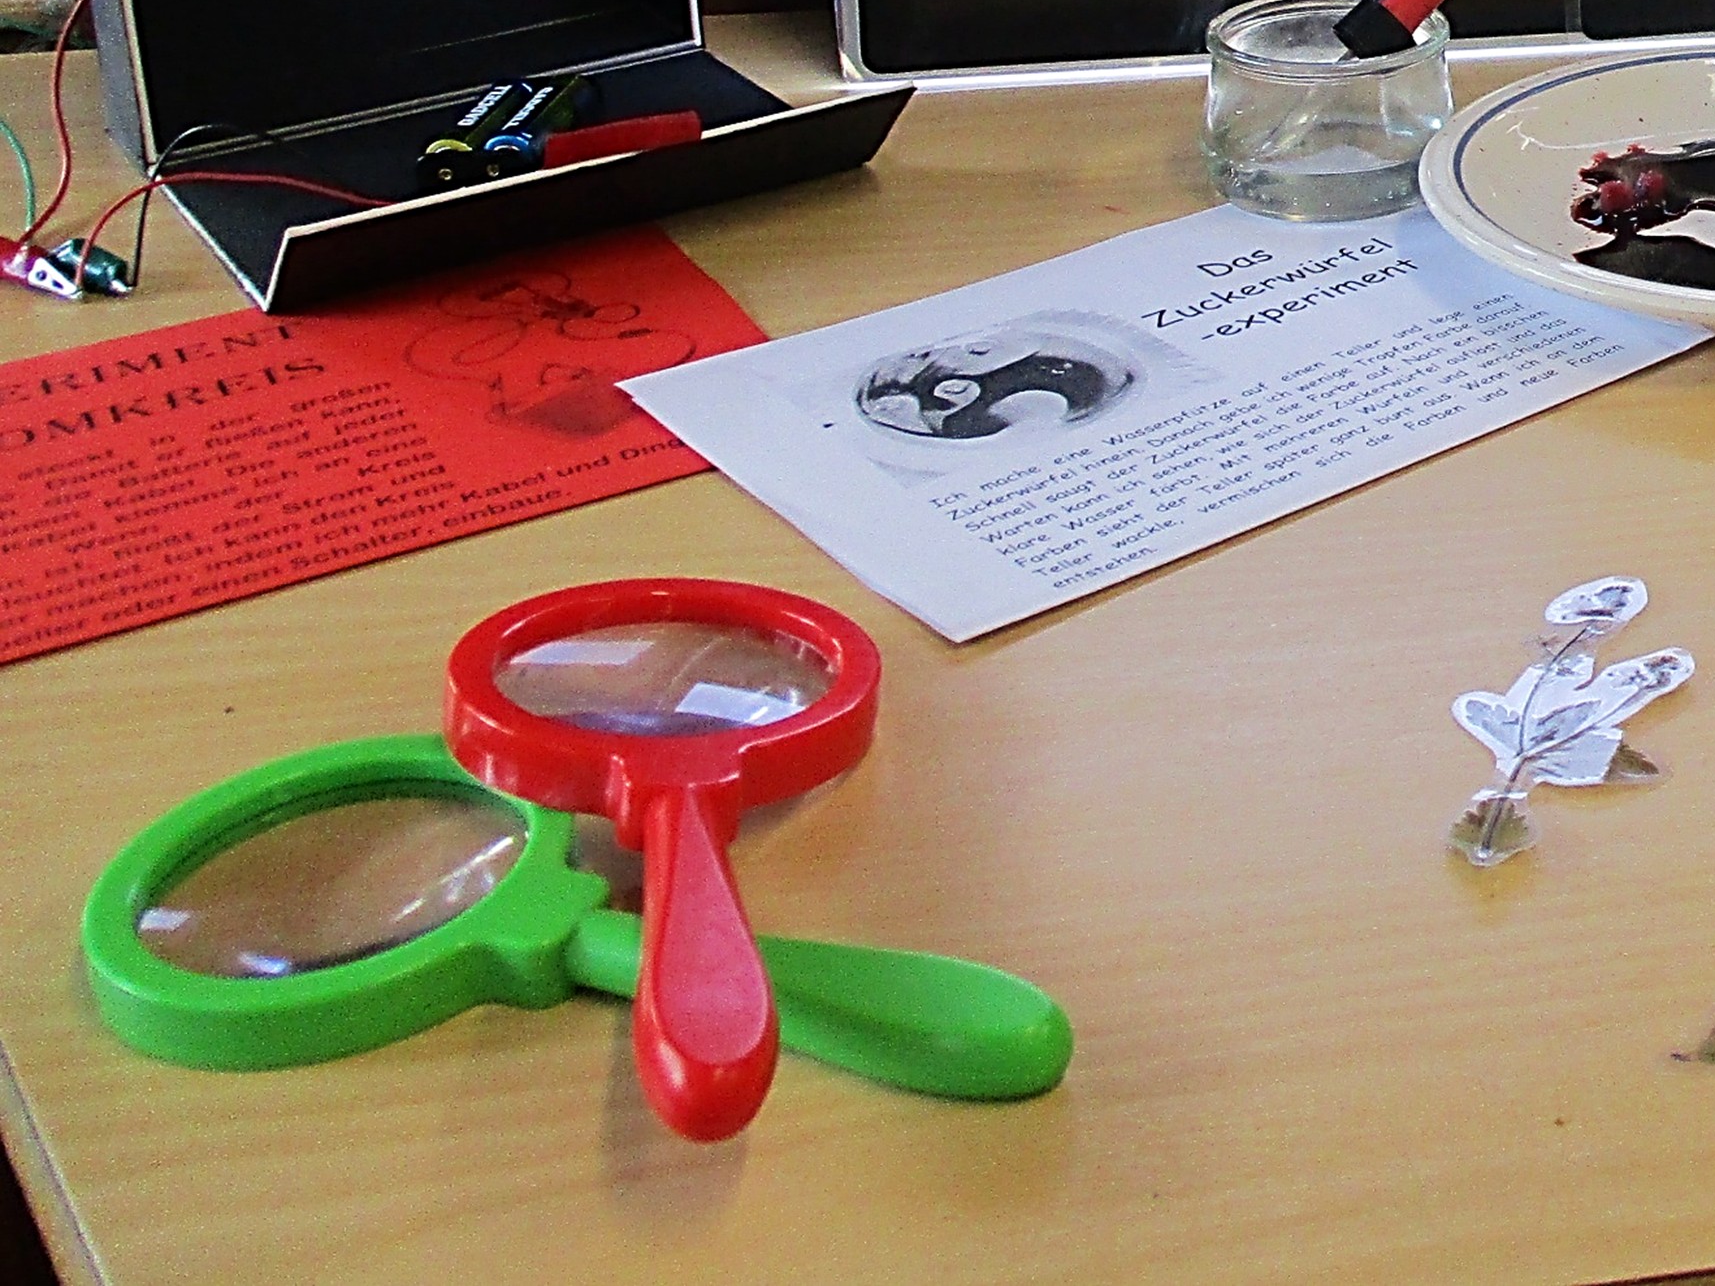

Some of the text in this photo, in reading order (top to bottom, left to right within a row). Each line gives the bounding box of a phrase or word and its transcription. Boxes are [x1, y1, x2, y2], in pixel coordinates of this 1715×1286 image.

[1140, 237, 1394, 329] Zuckerwürfel
[1196, 248, 1274, 278] Das
[1200, 256, 1420, 340] -experiment
[928, 492, 967, 508] Ich
[979, 466, 1040, 491] mache
[1052, 448, 1090, 464] eine
[1240, 381, 1267, 397] auf
[1280, 361, 1325, 382] einen
[1331, 339, 1380, 358] Teller
[1392, 324, 1423, 338] und
[1428, 310, 1465, 324] lege
[1472, 294, 1513, 310] einen
[964, 500, 1036, 531] Schnell
[1045, 479, 1095, 503] saugt
[1106, 463, 1137, 479] der
[1275, 402, 1302, 415] die
[1305, 380, 1359, 402] Farbe
[1400, 346, 1446, 365] Nach
[1452, 335, 1478, 347] ein
[1481, 310, 1549, 336] bisschen
[979, 513, 1058, 543] Warten
[1060, 493, 1109, 513] kann
[1116, 479, 1146, 493] ich
[1151, 456, 1216, 479] sehen,
[1216, 439, 1244, 454] wie
[1252, 423, 1290, 440] sich
[1295, 408, 1323, 423] der
[1507, 328, 1536, 342] und
[1539, 318, 1567, 330] das
[1146, 420, 1214, 447] Danach
[1218, 403, 1261, 423] gebe
[1265, 390, 1292, 403] ich
[1296, 367, 1352, 392] wenige
[1353, 340, 1422, 367] Tropfen
[1422, 322, 1472, 342] Farbe
[282, 485, 373, 514] Strom
[390, 464, 446, 485] und
[357, 451, 435, 477] Kreis
[371, 500, 445, 527] mehr
[459, 472, 545, 502] Kabel
[556, 454, 610, 477] und
[996, 534, 1050, 555] klare
[1061, 499, 1133, 530] Wasser
[1219, 454, 1250, 469] Mit
[1263, 417, 1348, 452] mehreren
[1437, 369, 1469, 384] und
[1479, 326, 1586, 368] verschiedenen
[1013, 538, 1086, 567] Farben
[1095, 513, 1143, 537] sieht
[1155, 496, 1186, 512] der
[1195, 470, 1252, 493] Teller
[1329, 425, 1369, 444] ganz
[1373, 406, 1414, 425] bunt
[1459, 371, 1510, 390] Wenn
[1515, 359, 1540, 371] ich
[1546, 349, 1568, 359] an
[1571, 335, 1604, 350] dem
[1031, 344, 1624, 576] Teller wackle, vermischen sich die Farben und neue Farben
[223, 522, 300, 548] kann
[310, 504, 366, 525] den
[374, 481, 454, 507] Kreis
